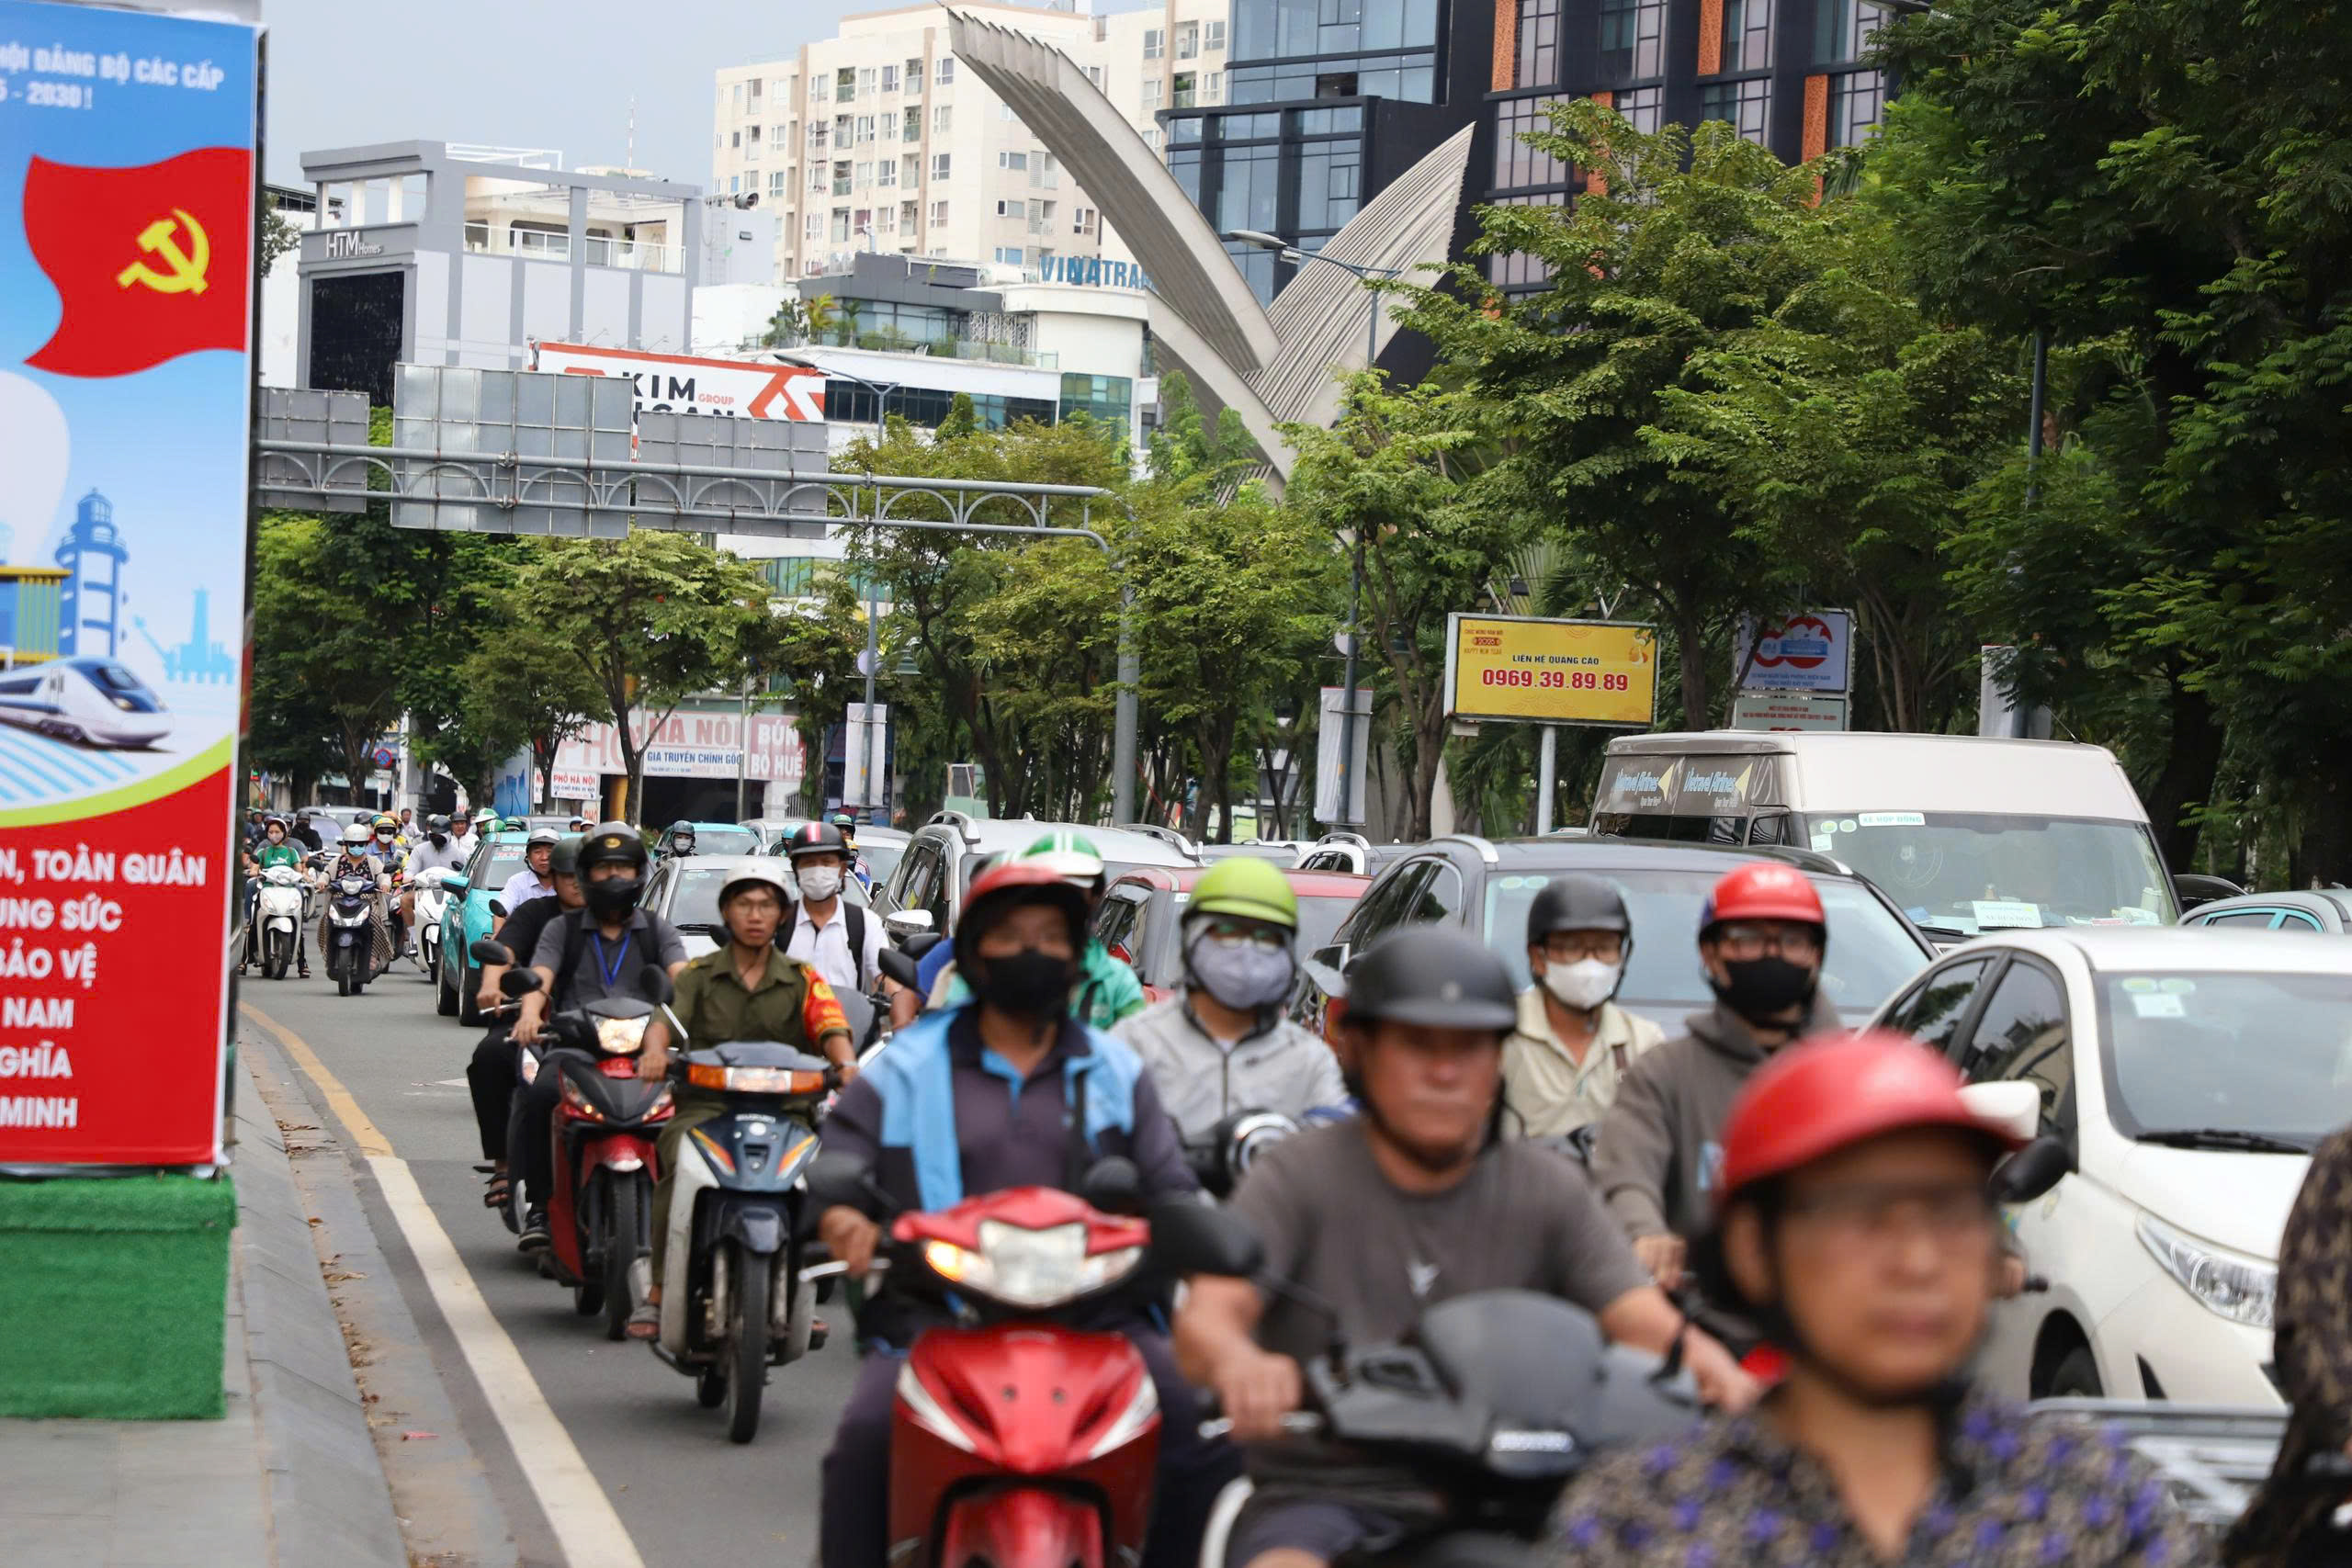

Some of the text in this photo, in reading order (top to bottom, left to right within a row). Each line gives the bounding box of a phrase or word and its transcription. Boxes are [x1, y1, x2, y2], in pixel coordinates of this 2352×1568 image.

[34, 43, 96, 77] ĐẢNG
[99, 51, 130, 85] BỘ
[134, 56, 178, 86] CÁC
[182, 60, 225, 91] CẤP
[27, 80, 82, 108] 2030
[326, 231, 382, 257] HTM Homes
[622, 372, 735, 405] KIM GROUP
[1482, 669, 1628, 692] 0969.39.89.89
[649, 714, 686, 744] HÀ
[758, 718, 799, 746] BÚN
[647, 751, 662, 762] GIA
[698, 752, 723, 764] CHÍNH
[774, 747, 804, 777] HUẾ
[32, 842, 116, 883] TOÀN
[122, 845, 207, 886] QUÂN
[61, 891, 123, 932] SỨC
[60, 942, 97, 989] VỆ
[3, 997, 74, 1029] NAM
[0, 1095, 79, 1130] MINH
